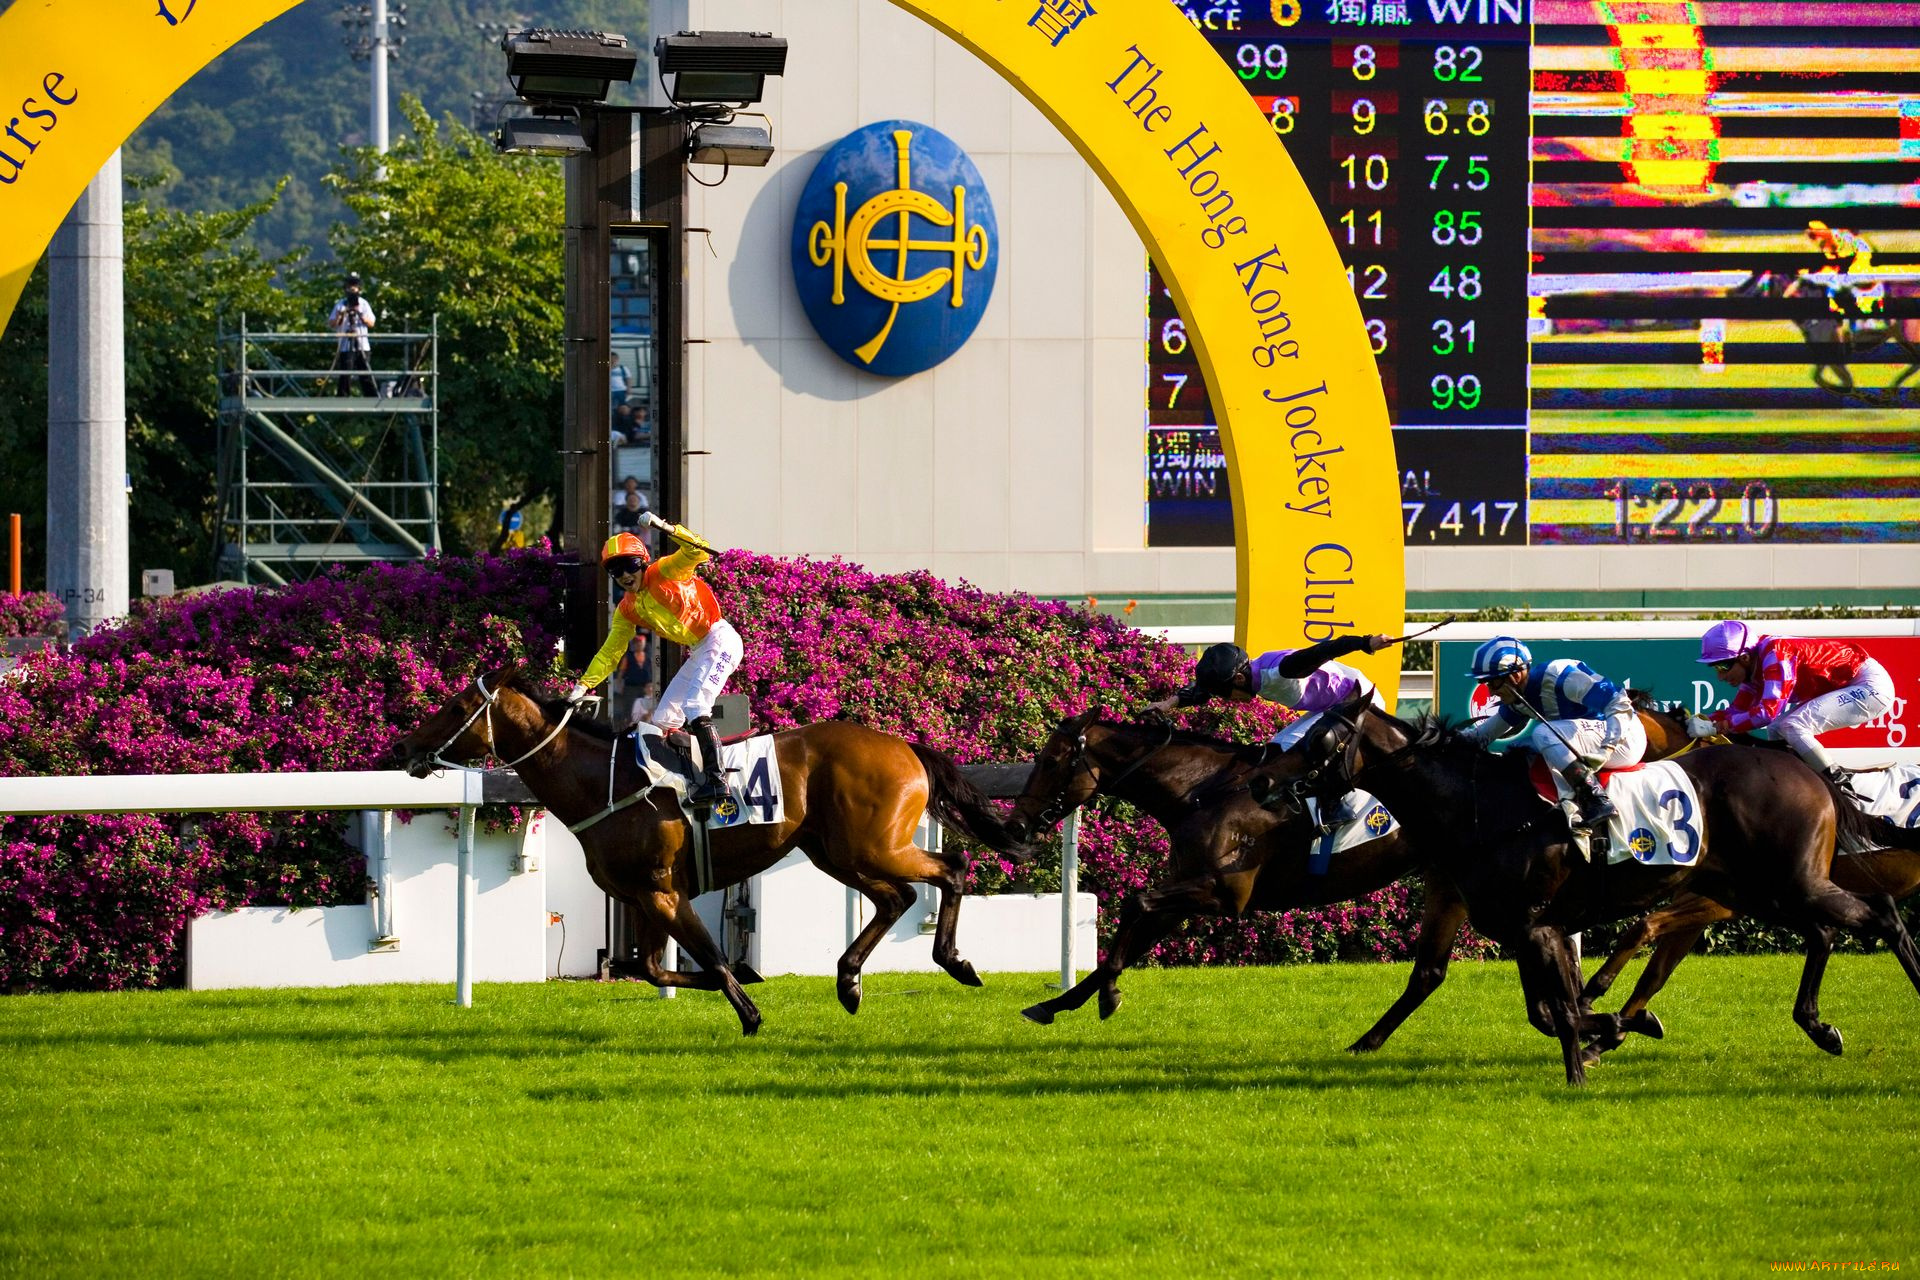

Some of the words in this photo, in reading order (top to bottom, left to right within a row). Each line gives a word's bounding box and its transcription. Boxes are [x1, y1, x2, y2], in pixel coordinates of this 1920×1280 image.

[1426, 0, 1522, 25] WIN
[1236, 43, 1288, 80] 99
[1351, 44, 1376, 81] 8
[1433, 46, 1483, 82] 82
[1105, 44, 1172, 132] The
[1351, 98, 1376, 135] 9
[1424, 99, 1490, 135] 6.8
[1163, 121, 1248, 249] Hong
[1340, 154, 1389, 190] 10
[1425, 155, 1490, 190] 7.5
[1340, 210, 1382, 245] 11
[1431, 210, 1483, 245] 85
[1346, 265, 1388, 299] 12
[1429, 265, 1482, 300] 48
[1233, 243, 1299, 367] Kong
[1162, 319, 1187, 354] 6
[1431, 320, 1475, 354] 31
[1163, 374, 1188, 408] 7
[1431, 374, 1482, 409] 99
[1262, 380, 1345, 519] Jockey
[1151, 471, 1217, 496] WIN
[1402, 502, 1518, 540] 7,417
[1303, 543, 1355, 642] Club
[744, 757, 778, 822] 4
[1659, 789, 1700, 863] 3
